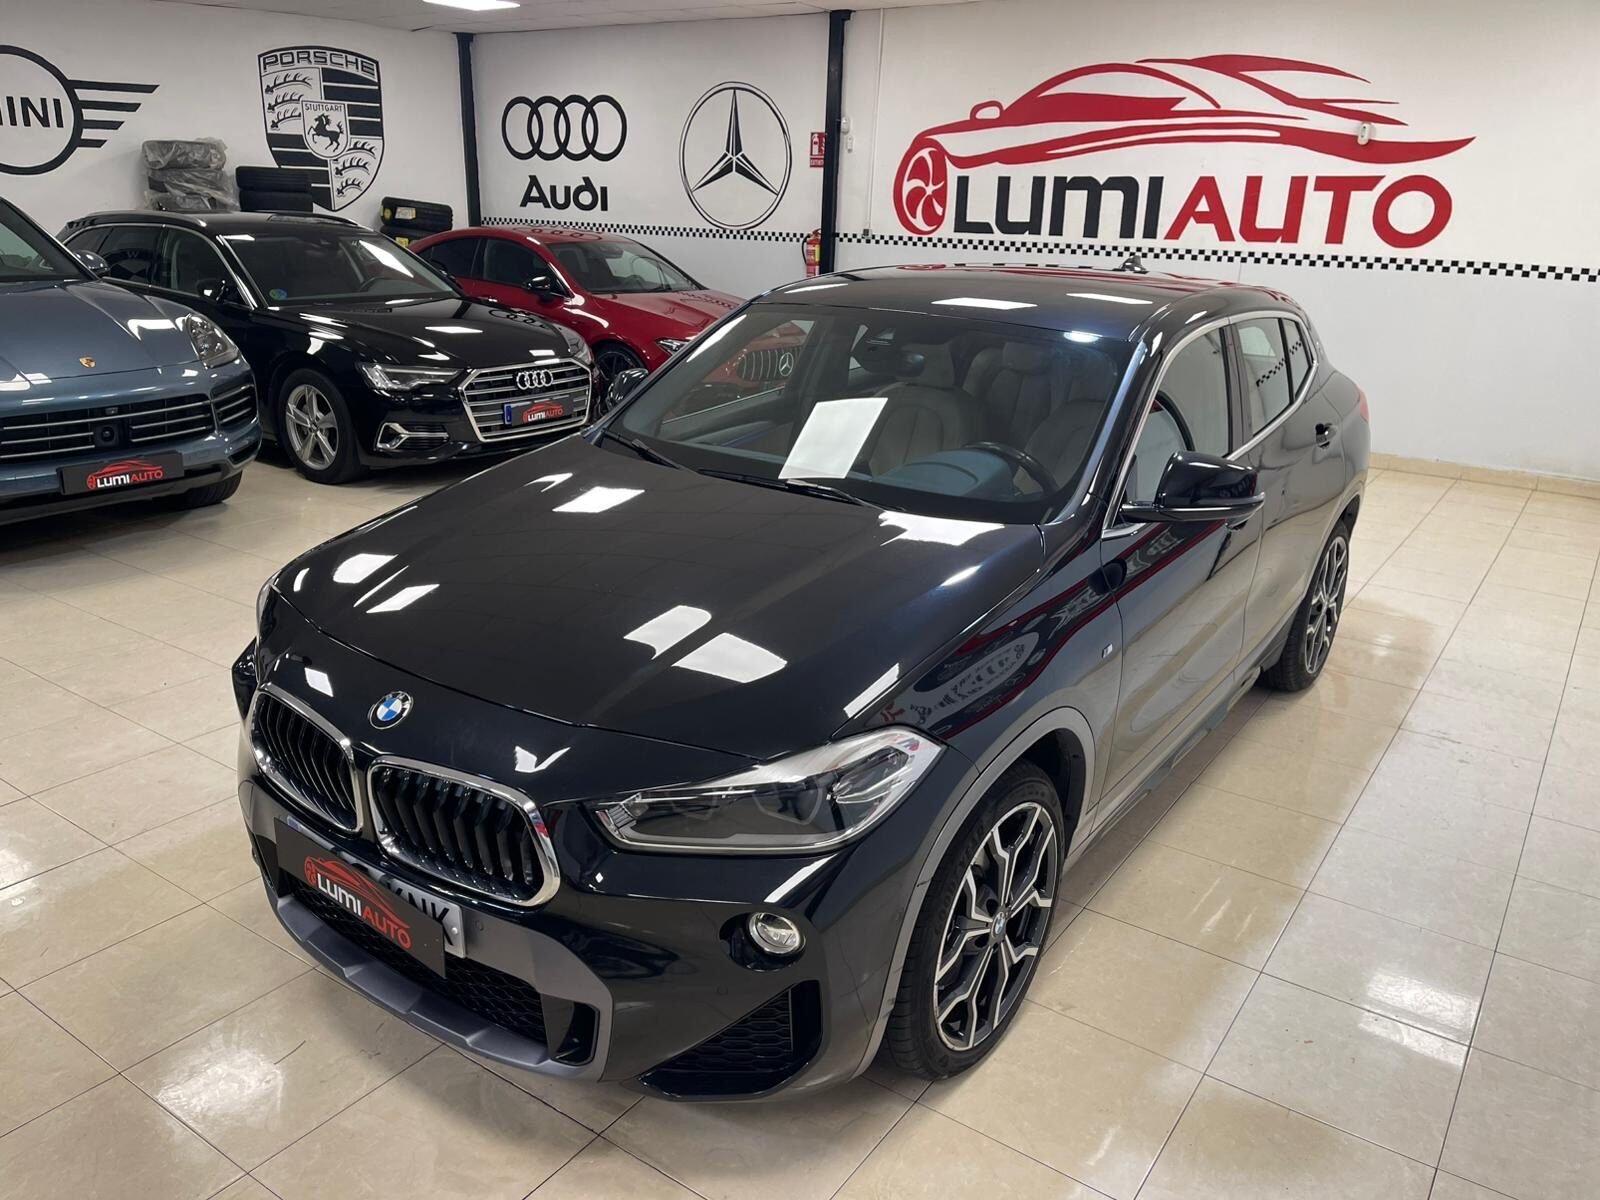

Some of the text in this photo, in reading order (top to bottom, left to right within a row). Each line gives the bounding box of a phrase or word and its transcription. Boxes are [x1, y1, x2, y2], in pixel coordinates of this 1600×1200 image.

[262, 51, 376, 77] PORSCHE
[0, 96, 64, 128] INI
[305, 103, 344, 111] STUTTGART
[519, 175, 608, 211] Audi
